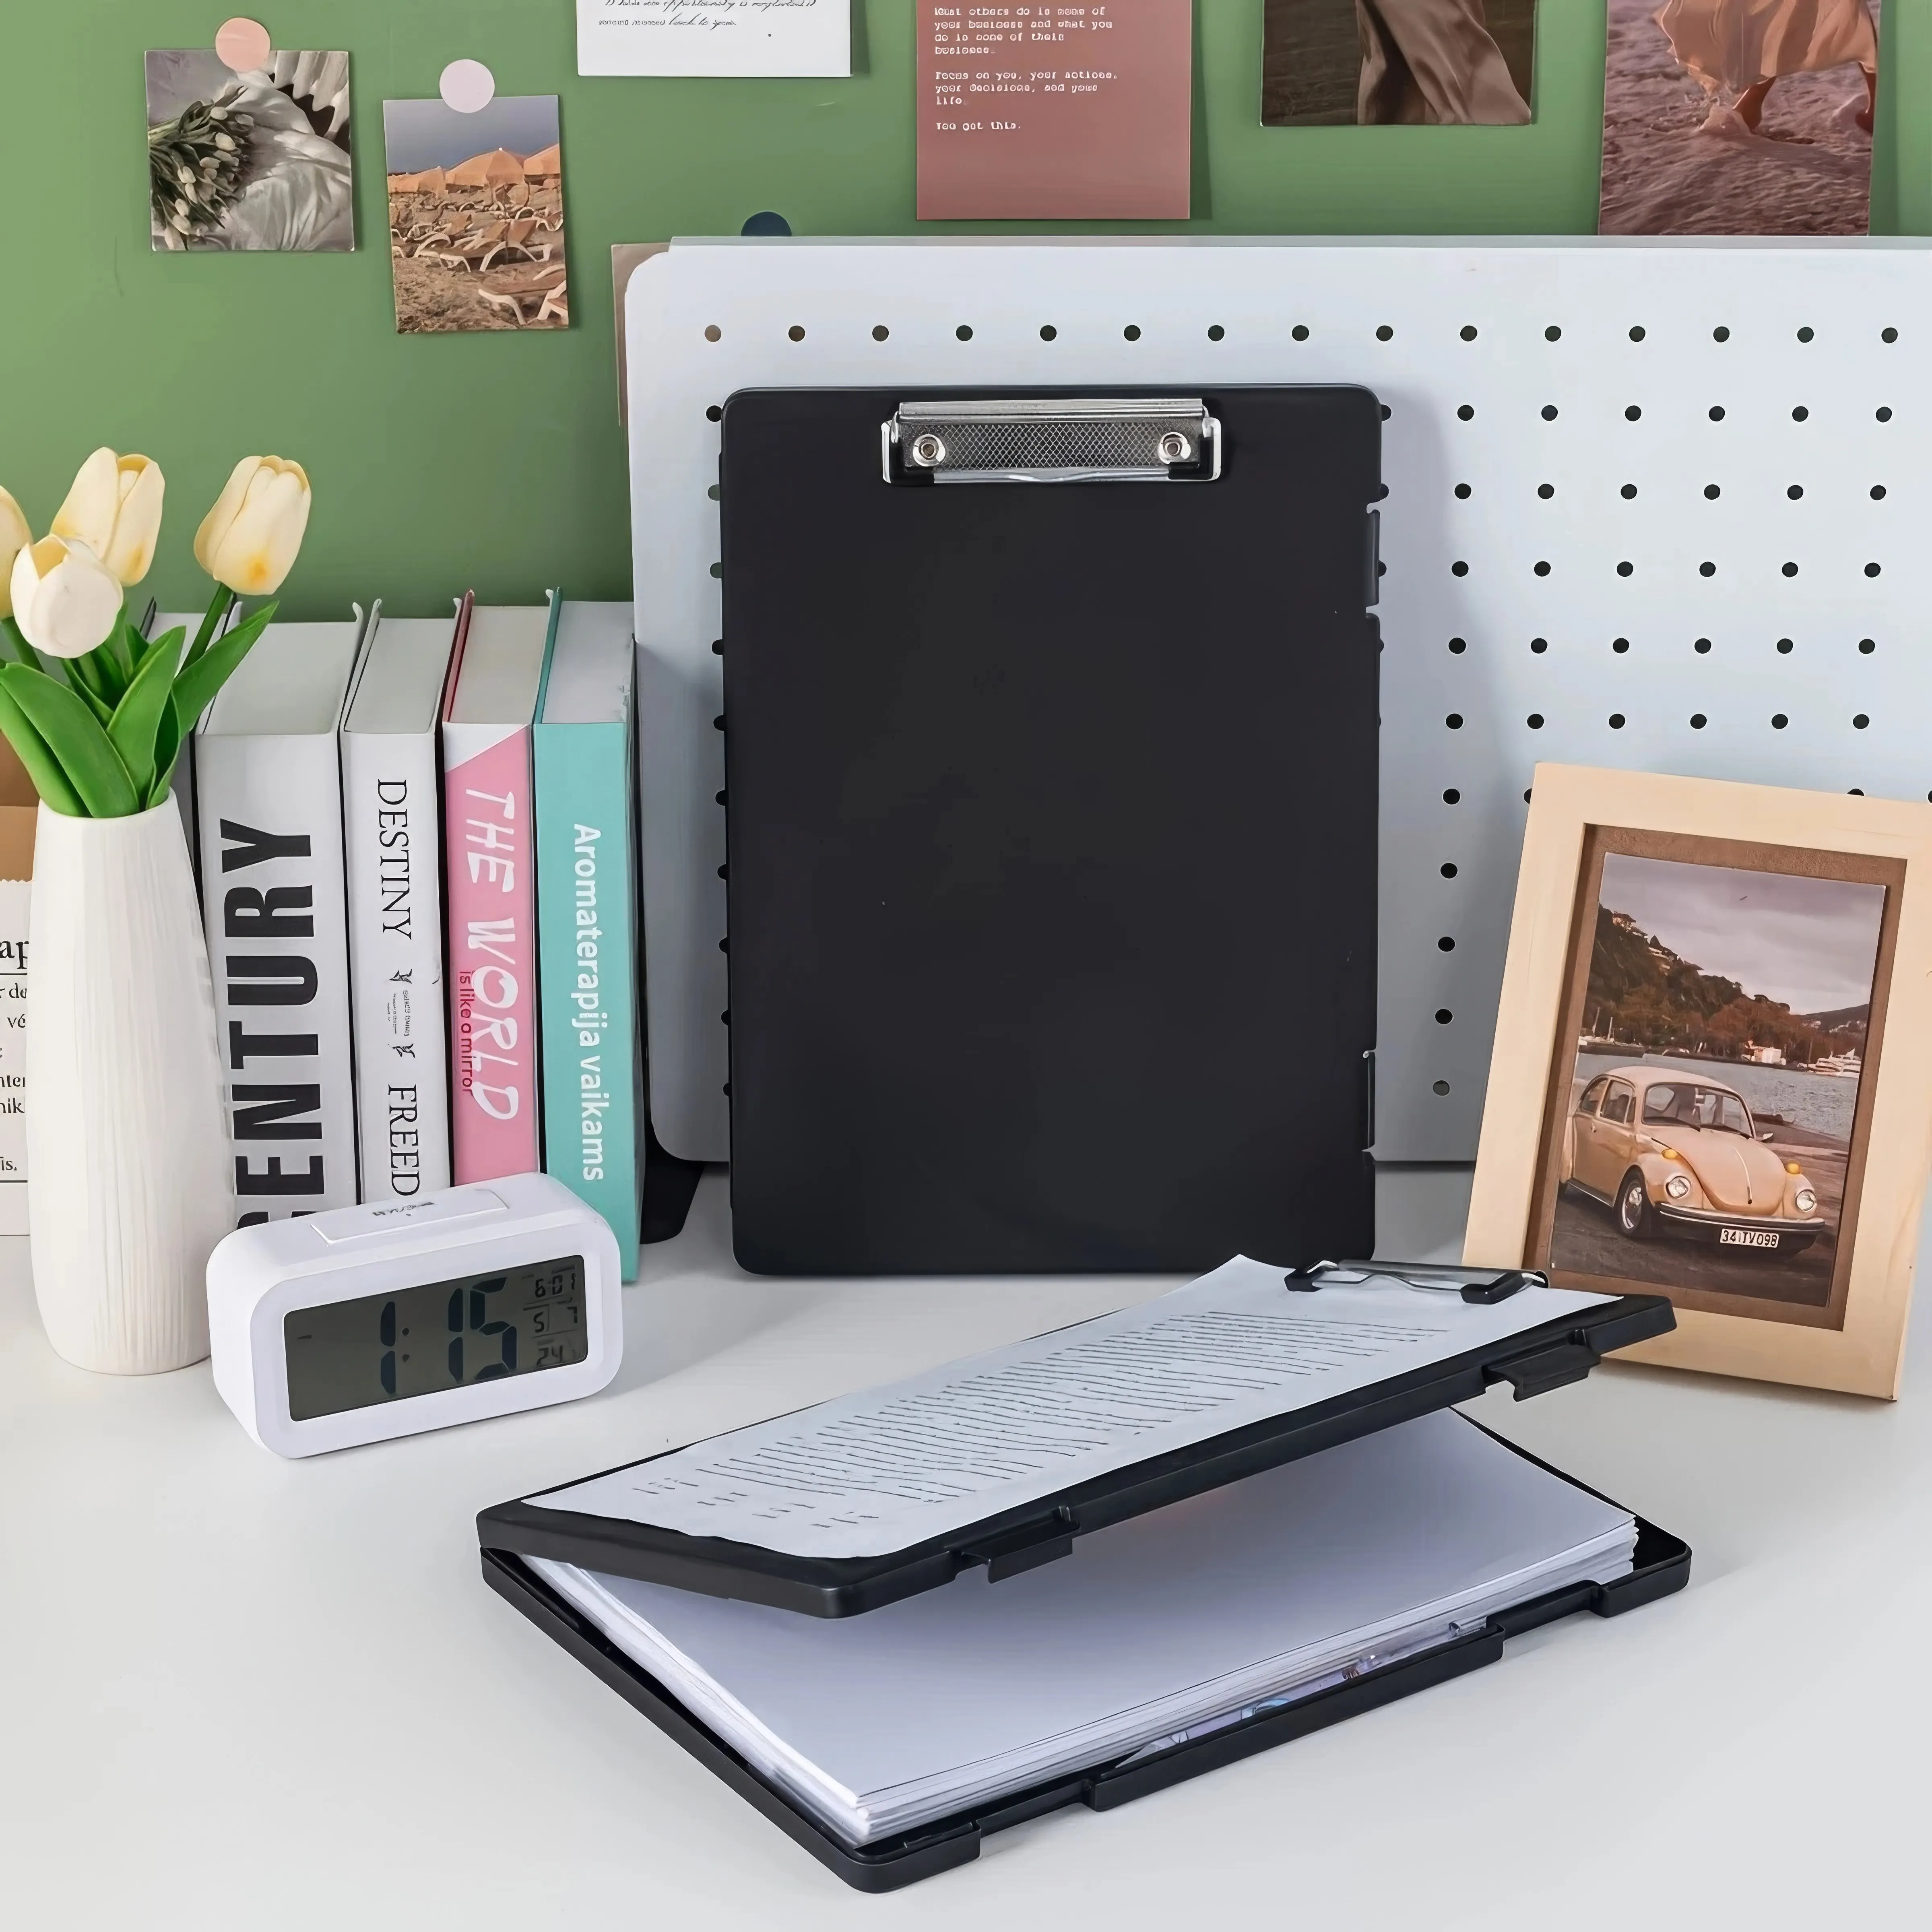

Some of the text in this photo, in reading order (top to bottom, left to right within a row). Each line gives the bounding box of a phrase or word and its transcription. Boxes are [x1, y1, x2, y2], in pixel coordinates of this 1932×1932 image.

[1016, 7, 1030, 16] do
[1091, 21, 1113, 30] you
[377, 778, 412, 941] DESTINY
[460, 989, 475, 1019] like
[464, 786, 520, 1121] THE WORLD
[570, 823, 610, 1181] Aromaterapija vaikams
[220, 818, 325, 1229] ENTURY
[461, 1023, 472, 1034] a
[461, 1038, 477, 1097] mirror
[388, 1083, 420, 1196] FREED
[380, 1277, 517, 1394] 1:15
